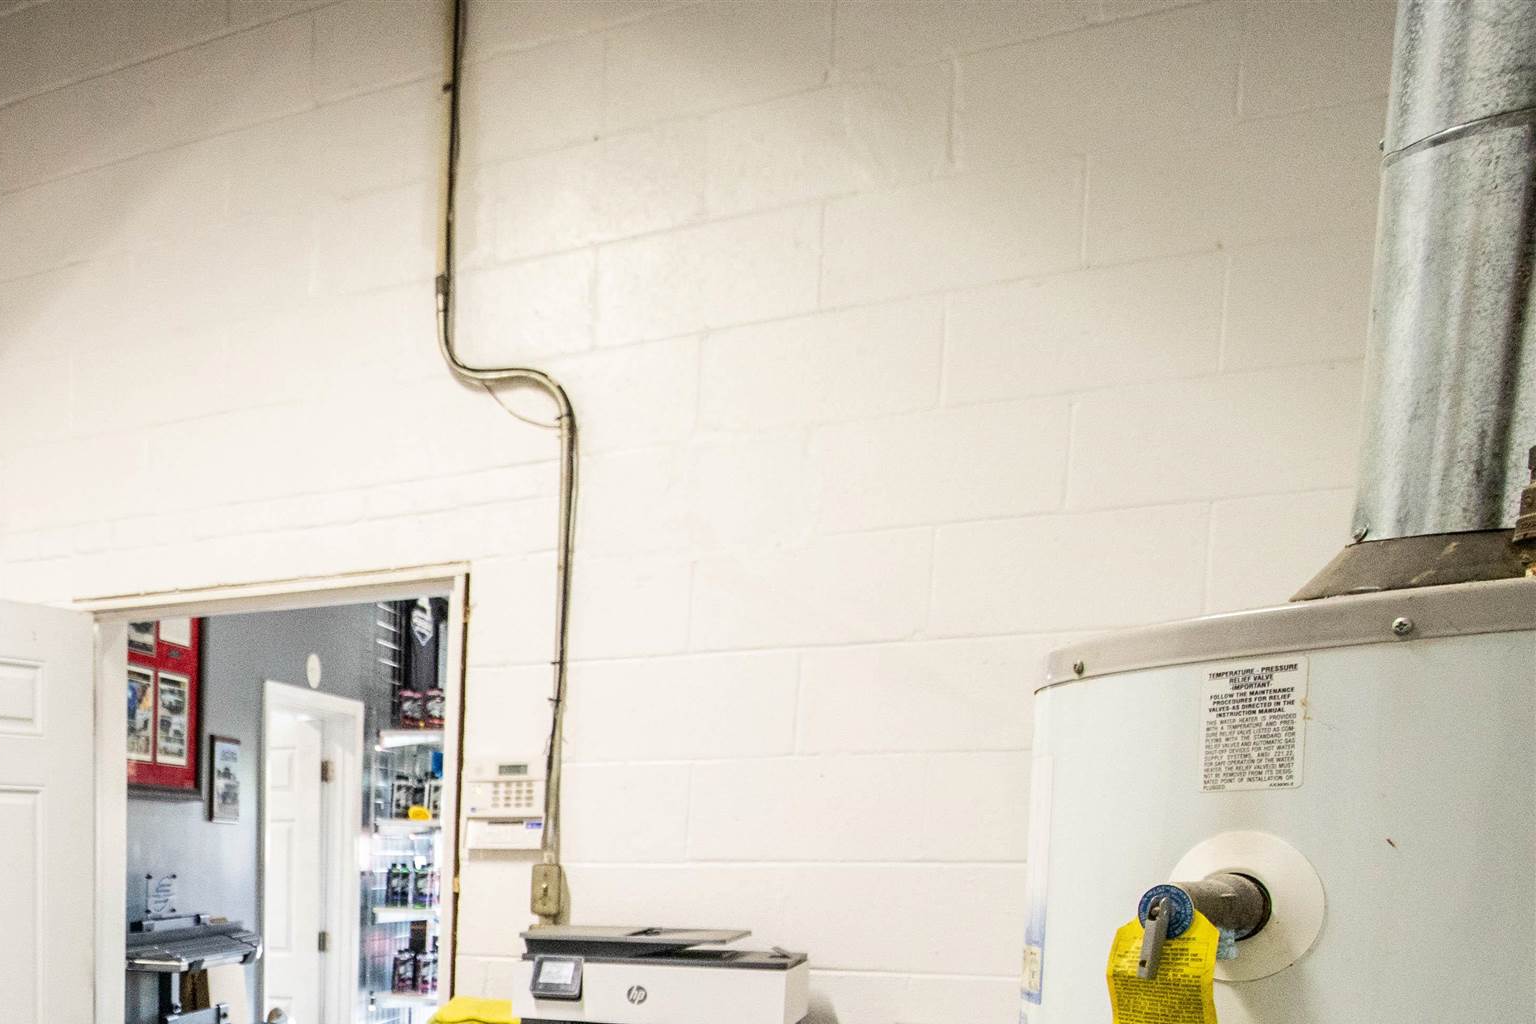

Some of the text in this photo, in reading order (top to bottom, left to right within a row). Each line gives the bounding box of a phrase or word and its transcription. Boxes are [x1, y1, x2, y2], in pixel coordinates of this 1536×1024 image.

[1208, 669, 1254, 678] TEMPERATURE
[1261, 664, 1298, 672] PRESSURE
[1249, 687, 1294, 696] MAINTENANCE
[1212, 698, 1252, 706] PROCEDURES
[1216, 710, 1256, 718] INSTRUCTION
[627, 985, 646, 1005] hp
